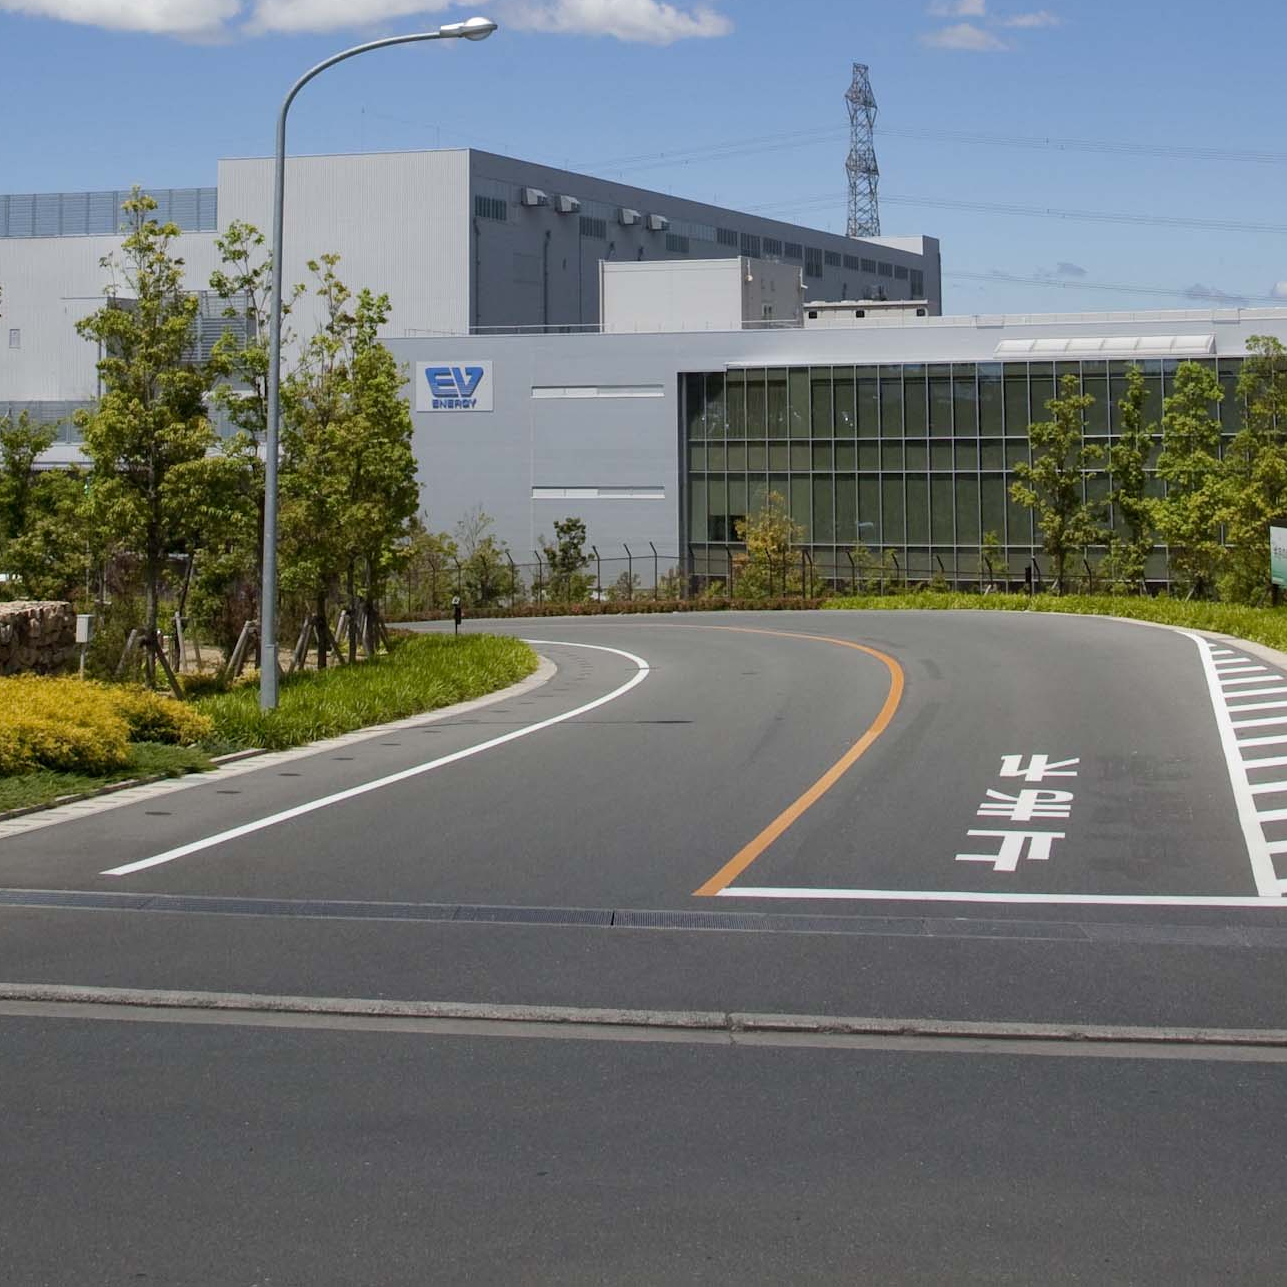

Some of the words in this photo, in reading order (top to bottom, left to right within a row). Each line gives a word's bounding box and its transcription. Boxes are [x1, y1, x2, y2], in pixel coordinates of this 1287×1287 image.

[425, 366, 484, 398] EV
[432, 398, 477, 409] ENERGY
[955, 754, 1080, 871] 止まれ
